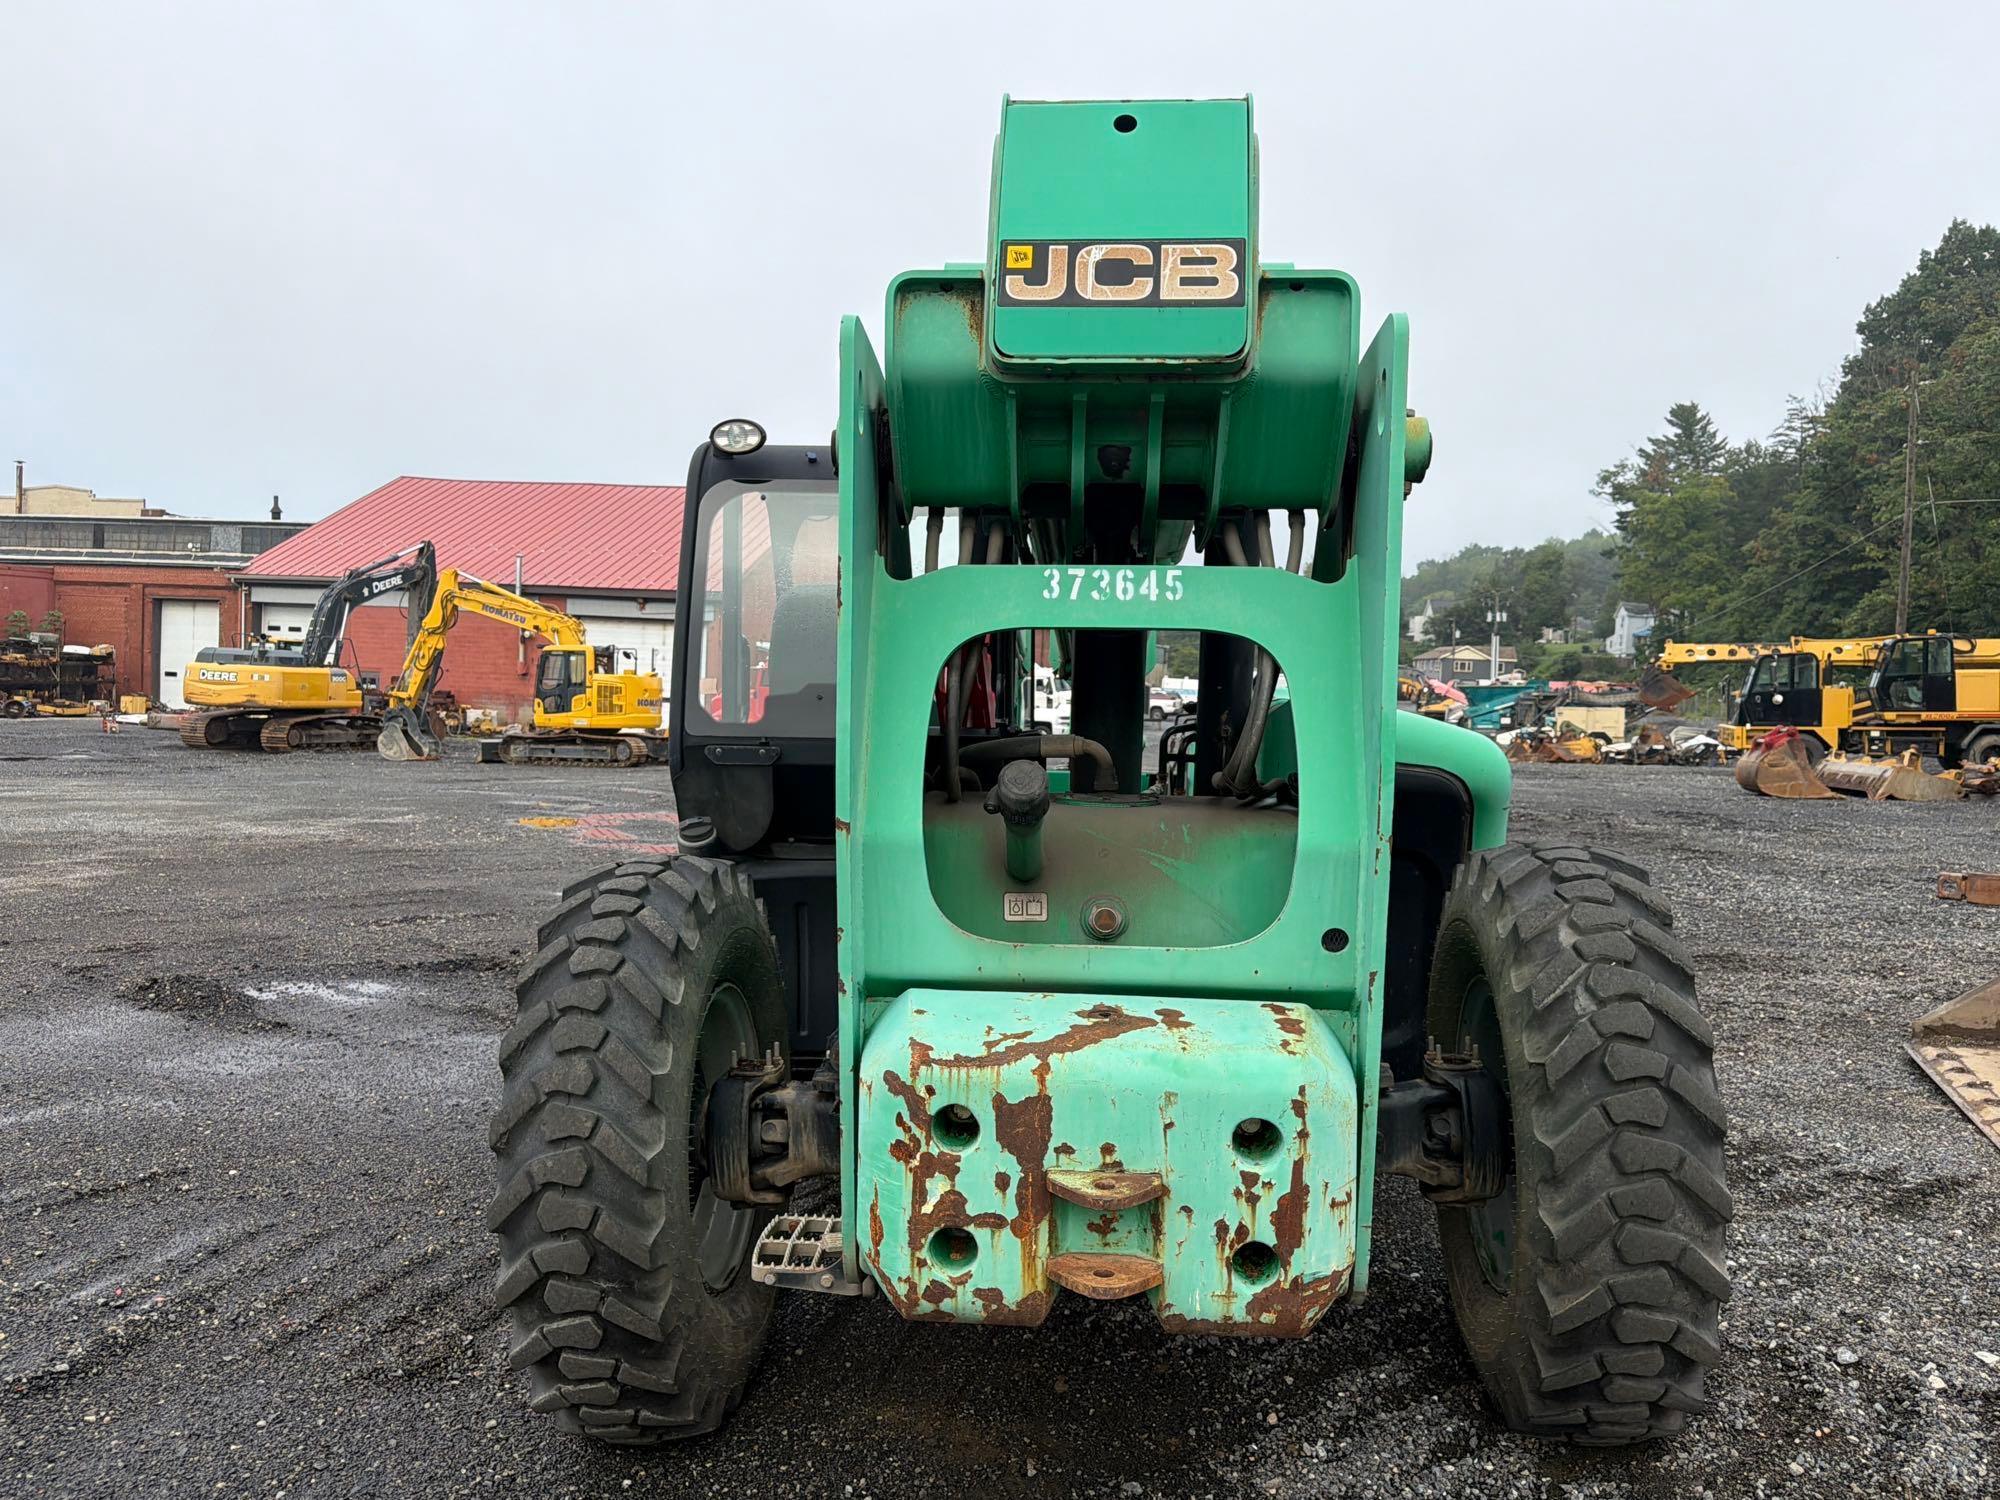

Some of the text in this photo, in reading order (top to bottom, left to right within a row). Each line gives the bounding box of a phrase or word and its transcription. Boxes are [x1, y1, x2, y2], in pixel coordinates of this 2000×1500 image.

[1005, 244, 1239, 300] JCB
[372, 575, 403, 594] DEERE
[1042, 568, 1184, 601] 373645
[482, 603, 526, 624] KOMATSU
[199, 669, 237, 682] DEERE
